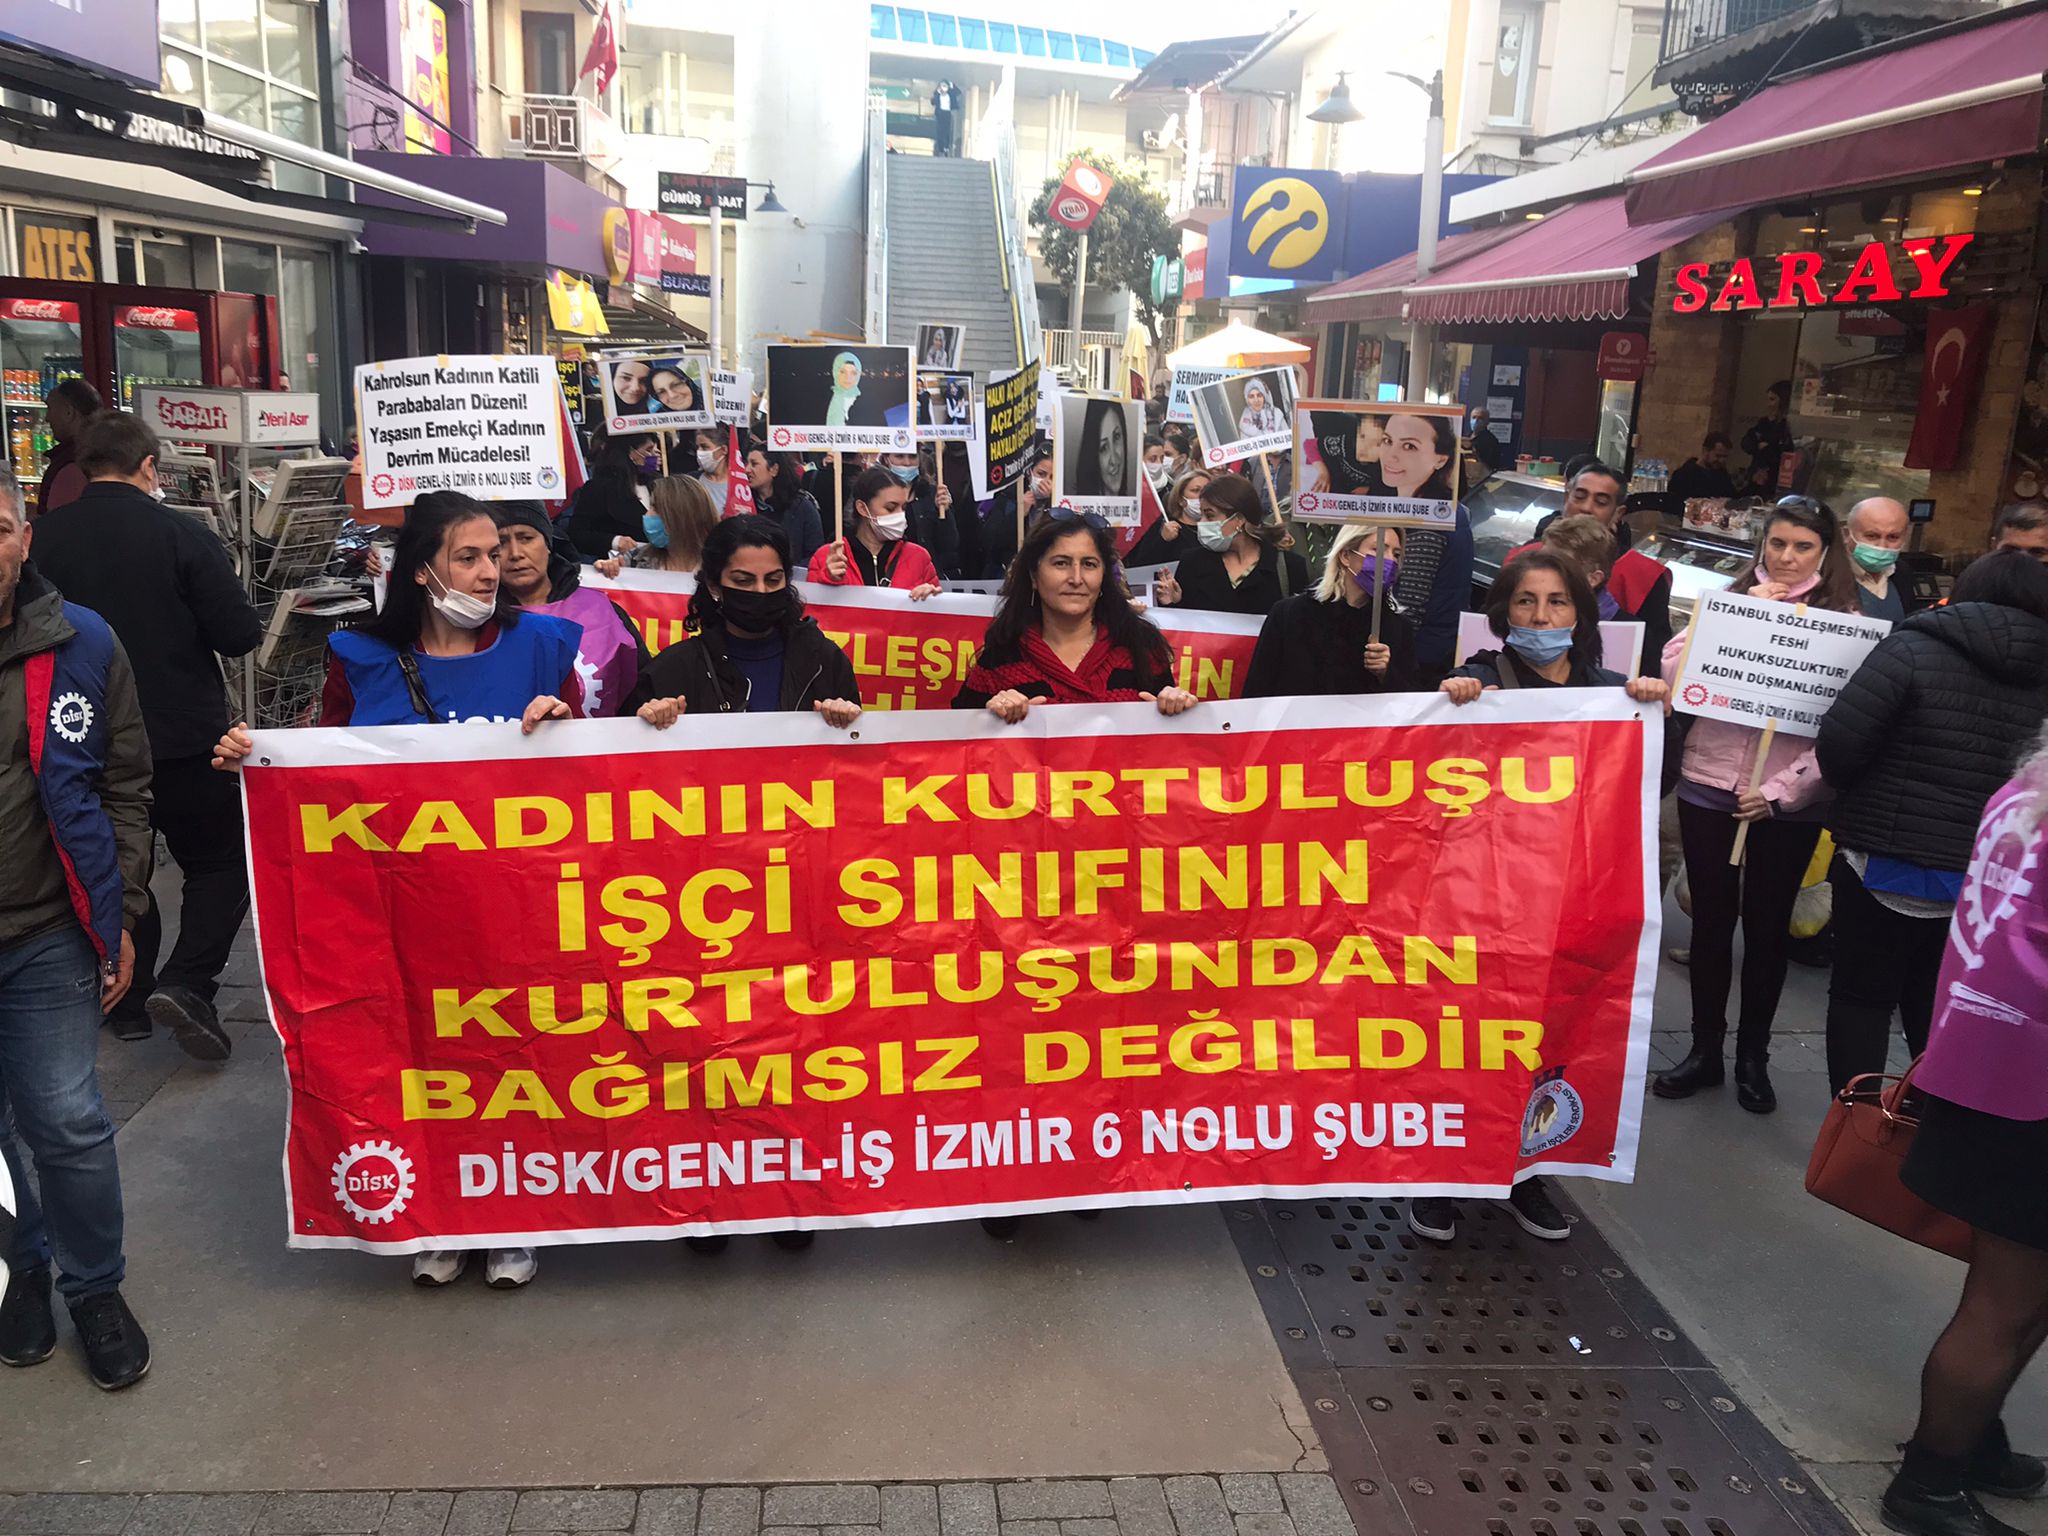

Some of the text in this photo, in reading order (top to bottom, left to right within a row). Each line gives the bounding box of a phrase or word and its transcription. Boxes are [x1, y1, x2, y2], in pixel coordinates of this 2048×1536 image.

[1672, 233, 1975, 313] SARAY
[364, 370, 430, 393] Kahrolsun
[434, 367, 494, 386] Kadının
[498, 366, 540, 385] Katili
[160, 402, 225, 429] SABAH
[377, 393, 528, 417] Parababaları Düzeni!
[264, 411, 310, 427] Yeni Asır
[370, 419, 546, 447] Yaşasın Emekçi Kadının
[387, 446, 531, 469] Devrim Mücadelesi!
[485, 472, 508, 486] NOLU
[510, 472, 532, 489] ŞUBE
[1393, 502, 1411, 514] NOLU
[1412, 504, 1430, 517] ŞUBE
[1706, 598, 1773, 622] İSTANBUL
[1769, 633, 1809, 651] FESHİ
[1700, 663, 1744, 682] KADIN
[300, 756, 1576, 853] KADININ KURTULUŞU
[557, 839, 1370, 967] İŞÇİ SINIFININ
[432, 935, 1478, 1038] KURTULUŞUNDAN
[401, 1036, 982, 1121] BAĞIMSIZ
[459, 1121, 895, 1198] DİSK/GENEL-İŞ
[914, 1107, 1075, 1172] İZMİR
[1092, 1112, 1122, 1159] 6
[1142, 1104, 1293, 1154] NOLU
[1313, 1102, 1466, 1160] ŞUBE
[349, 1169, 397, 1193] DİSK
